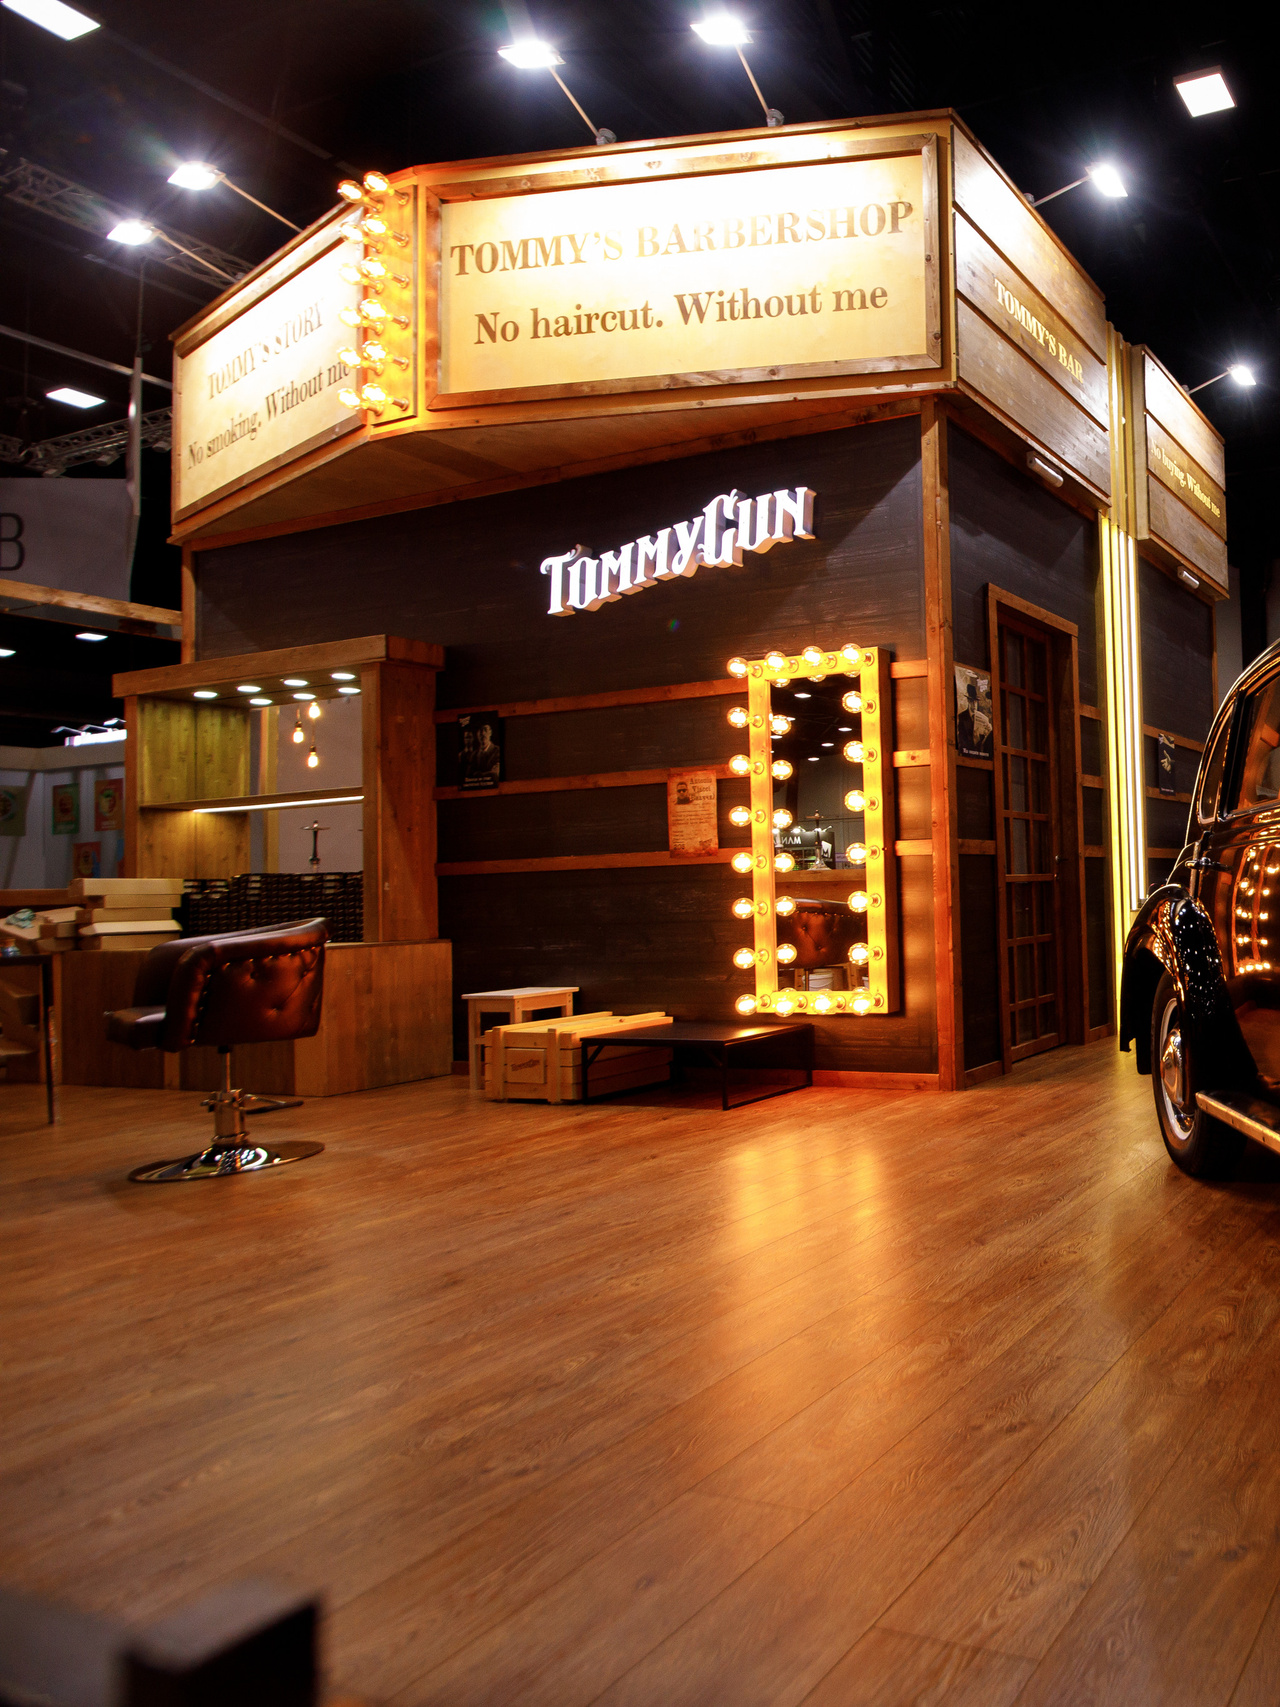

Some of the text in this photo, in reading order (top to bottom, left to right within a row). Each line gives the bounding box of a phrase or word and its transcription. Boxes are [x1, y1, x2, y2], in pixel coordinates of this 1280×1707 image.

[450, 201, 913, 276] TOMMY'S BARBERSHOP
[208, 299, 326, 400] TOMMY'S STORY
[474, 284, 888, 344] No haircut. Without me
[994, 278, 1084, 384] TOMMY'S BAR
[188, 361, 350, 470] No smoking. Without me
[1151, 438, 1161, 460] No
[1187, 473, 1211, 509] Without
[1211, 501, 1221, 518] me
